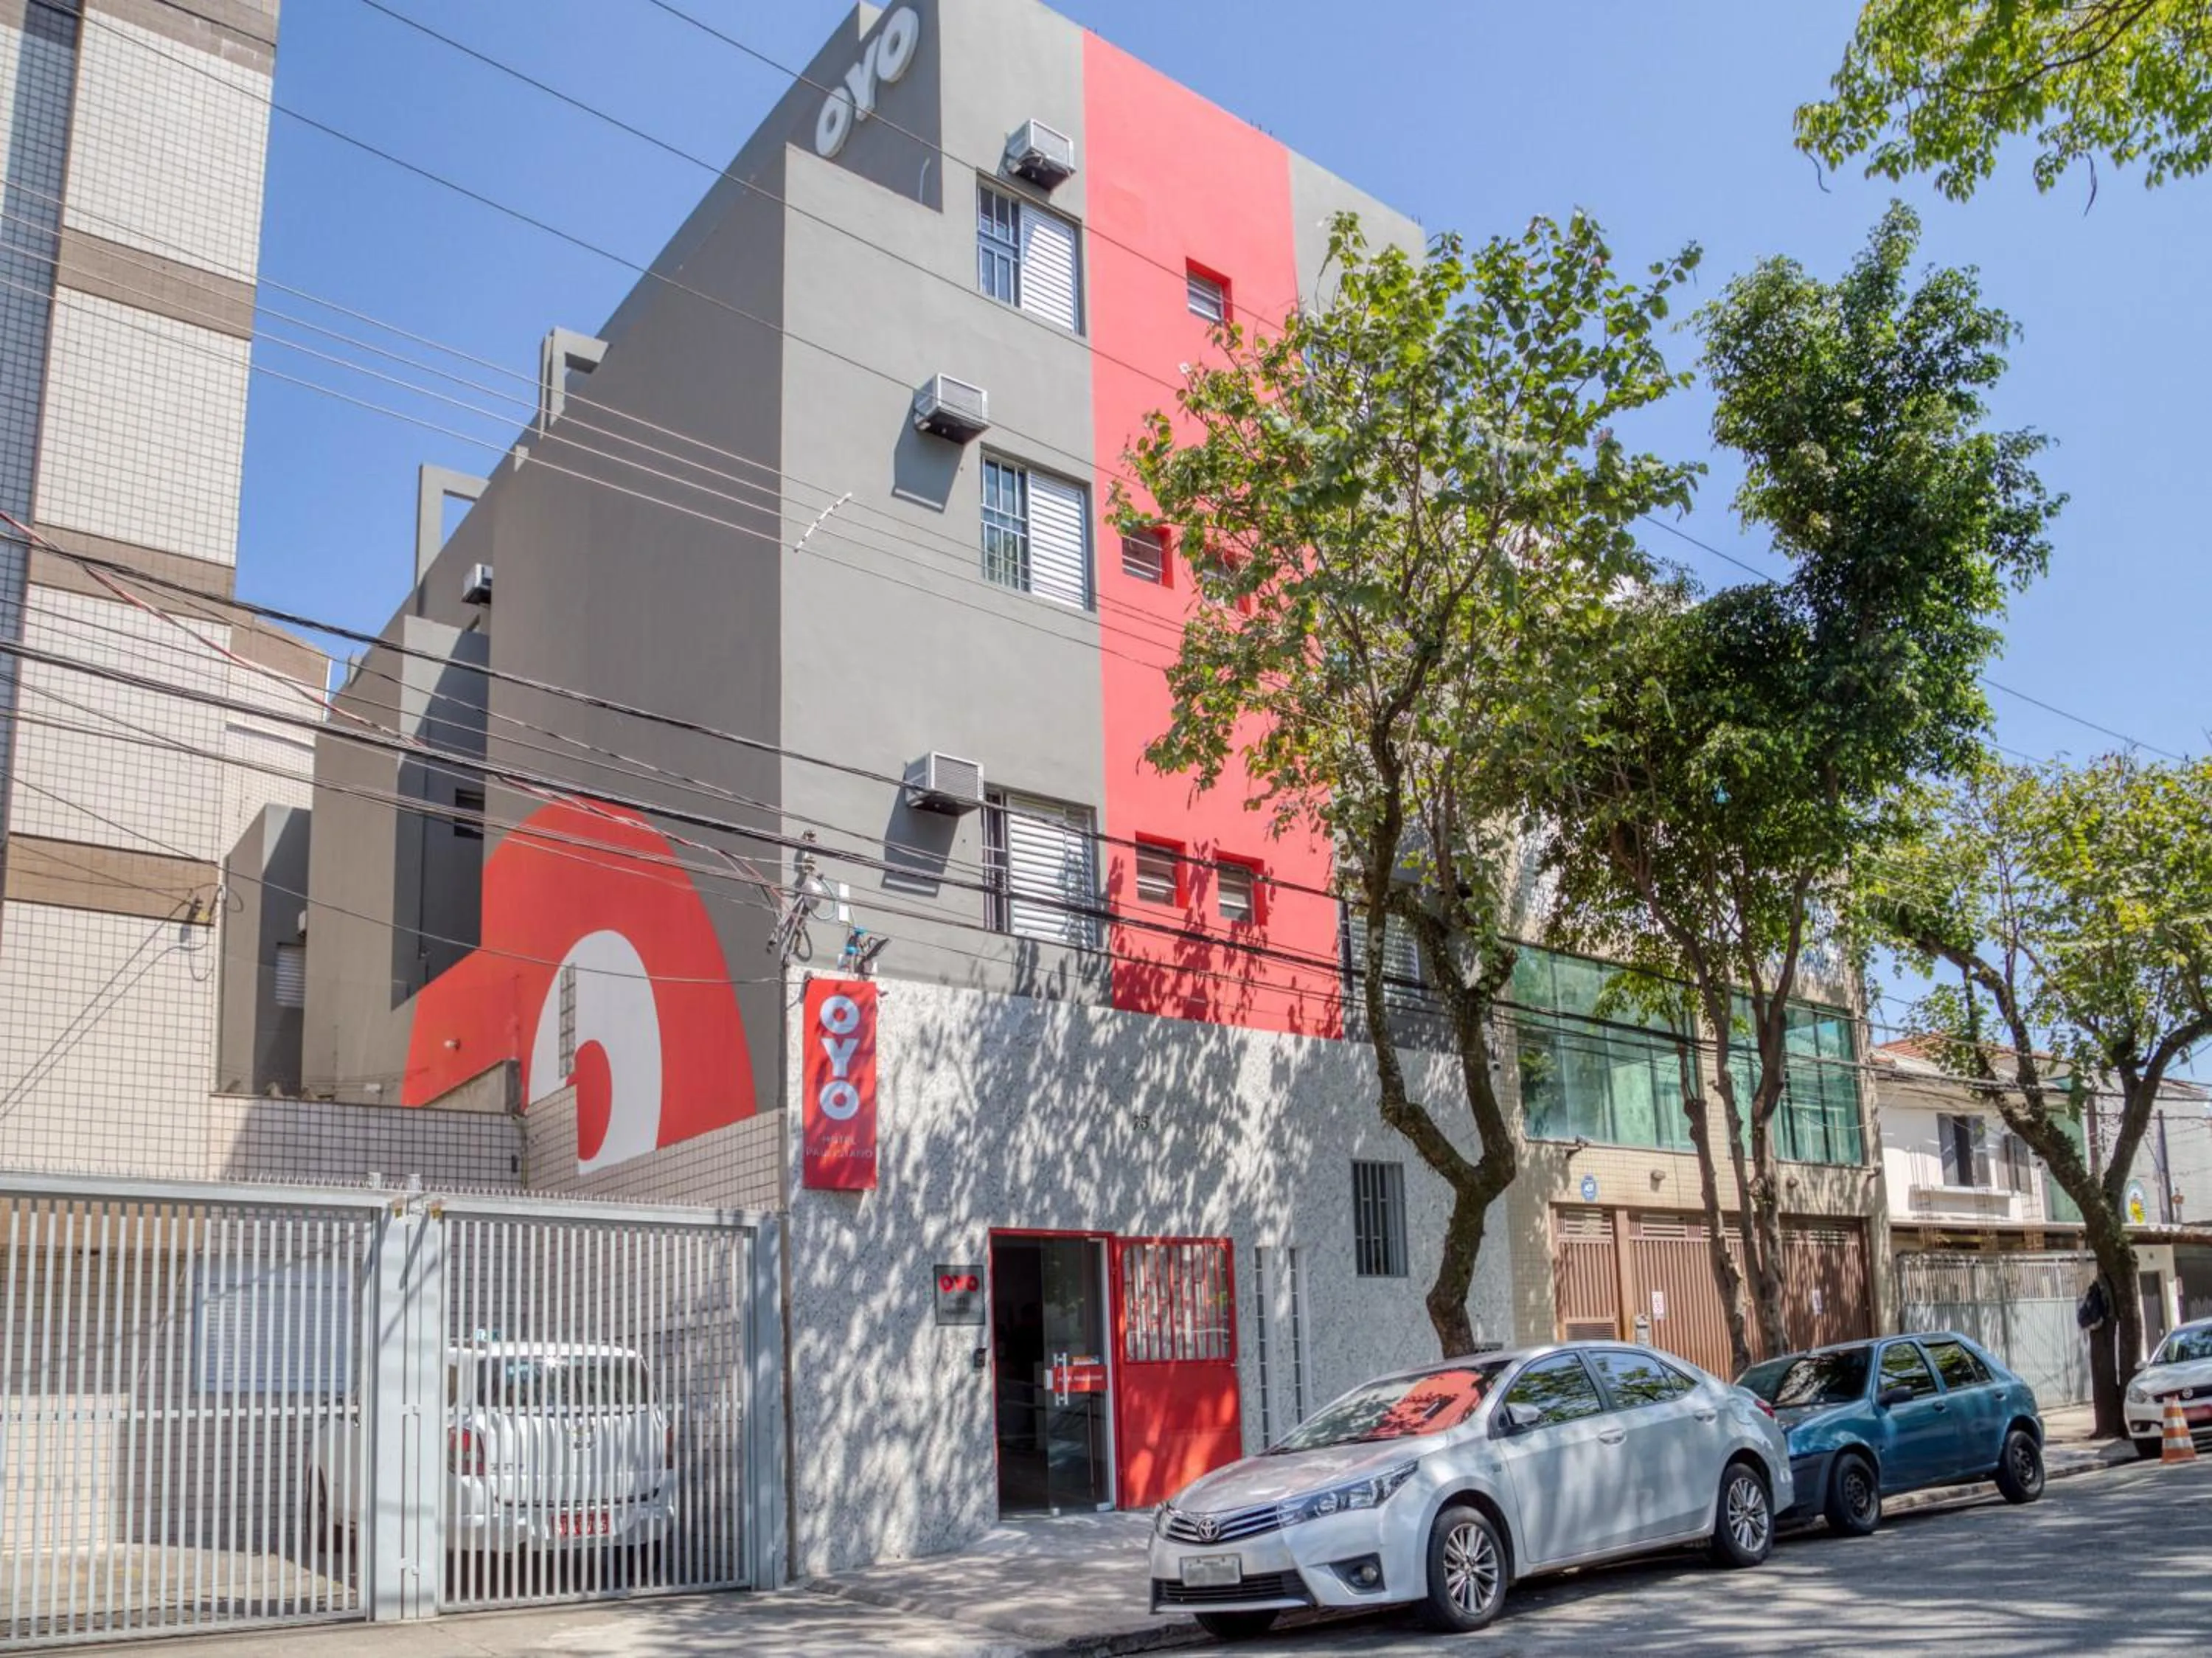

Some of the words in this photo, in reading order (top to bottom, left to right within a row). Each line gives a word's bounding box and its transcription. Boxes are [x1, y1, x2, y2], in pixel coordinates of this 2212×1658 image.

[815, 6, 919, 159] OYO
[819, 994, 860, 1120] OYO
[939, 1274, 979, 1293] OYO
